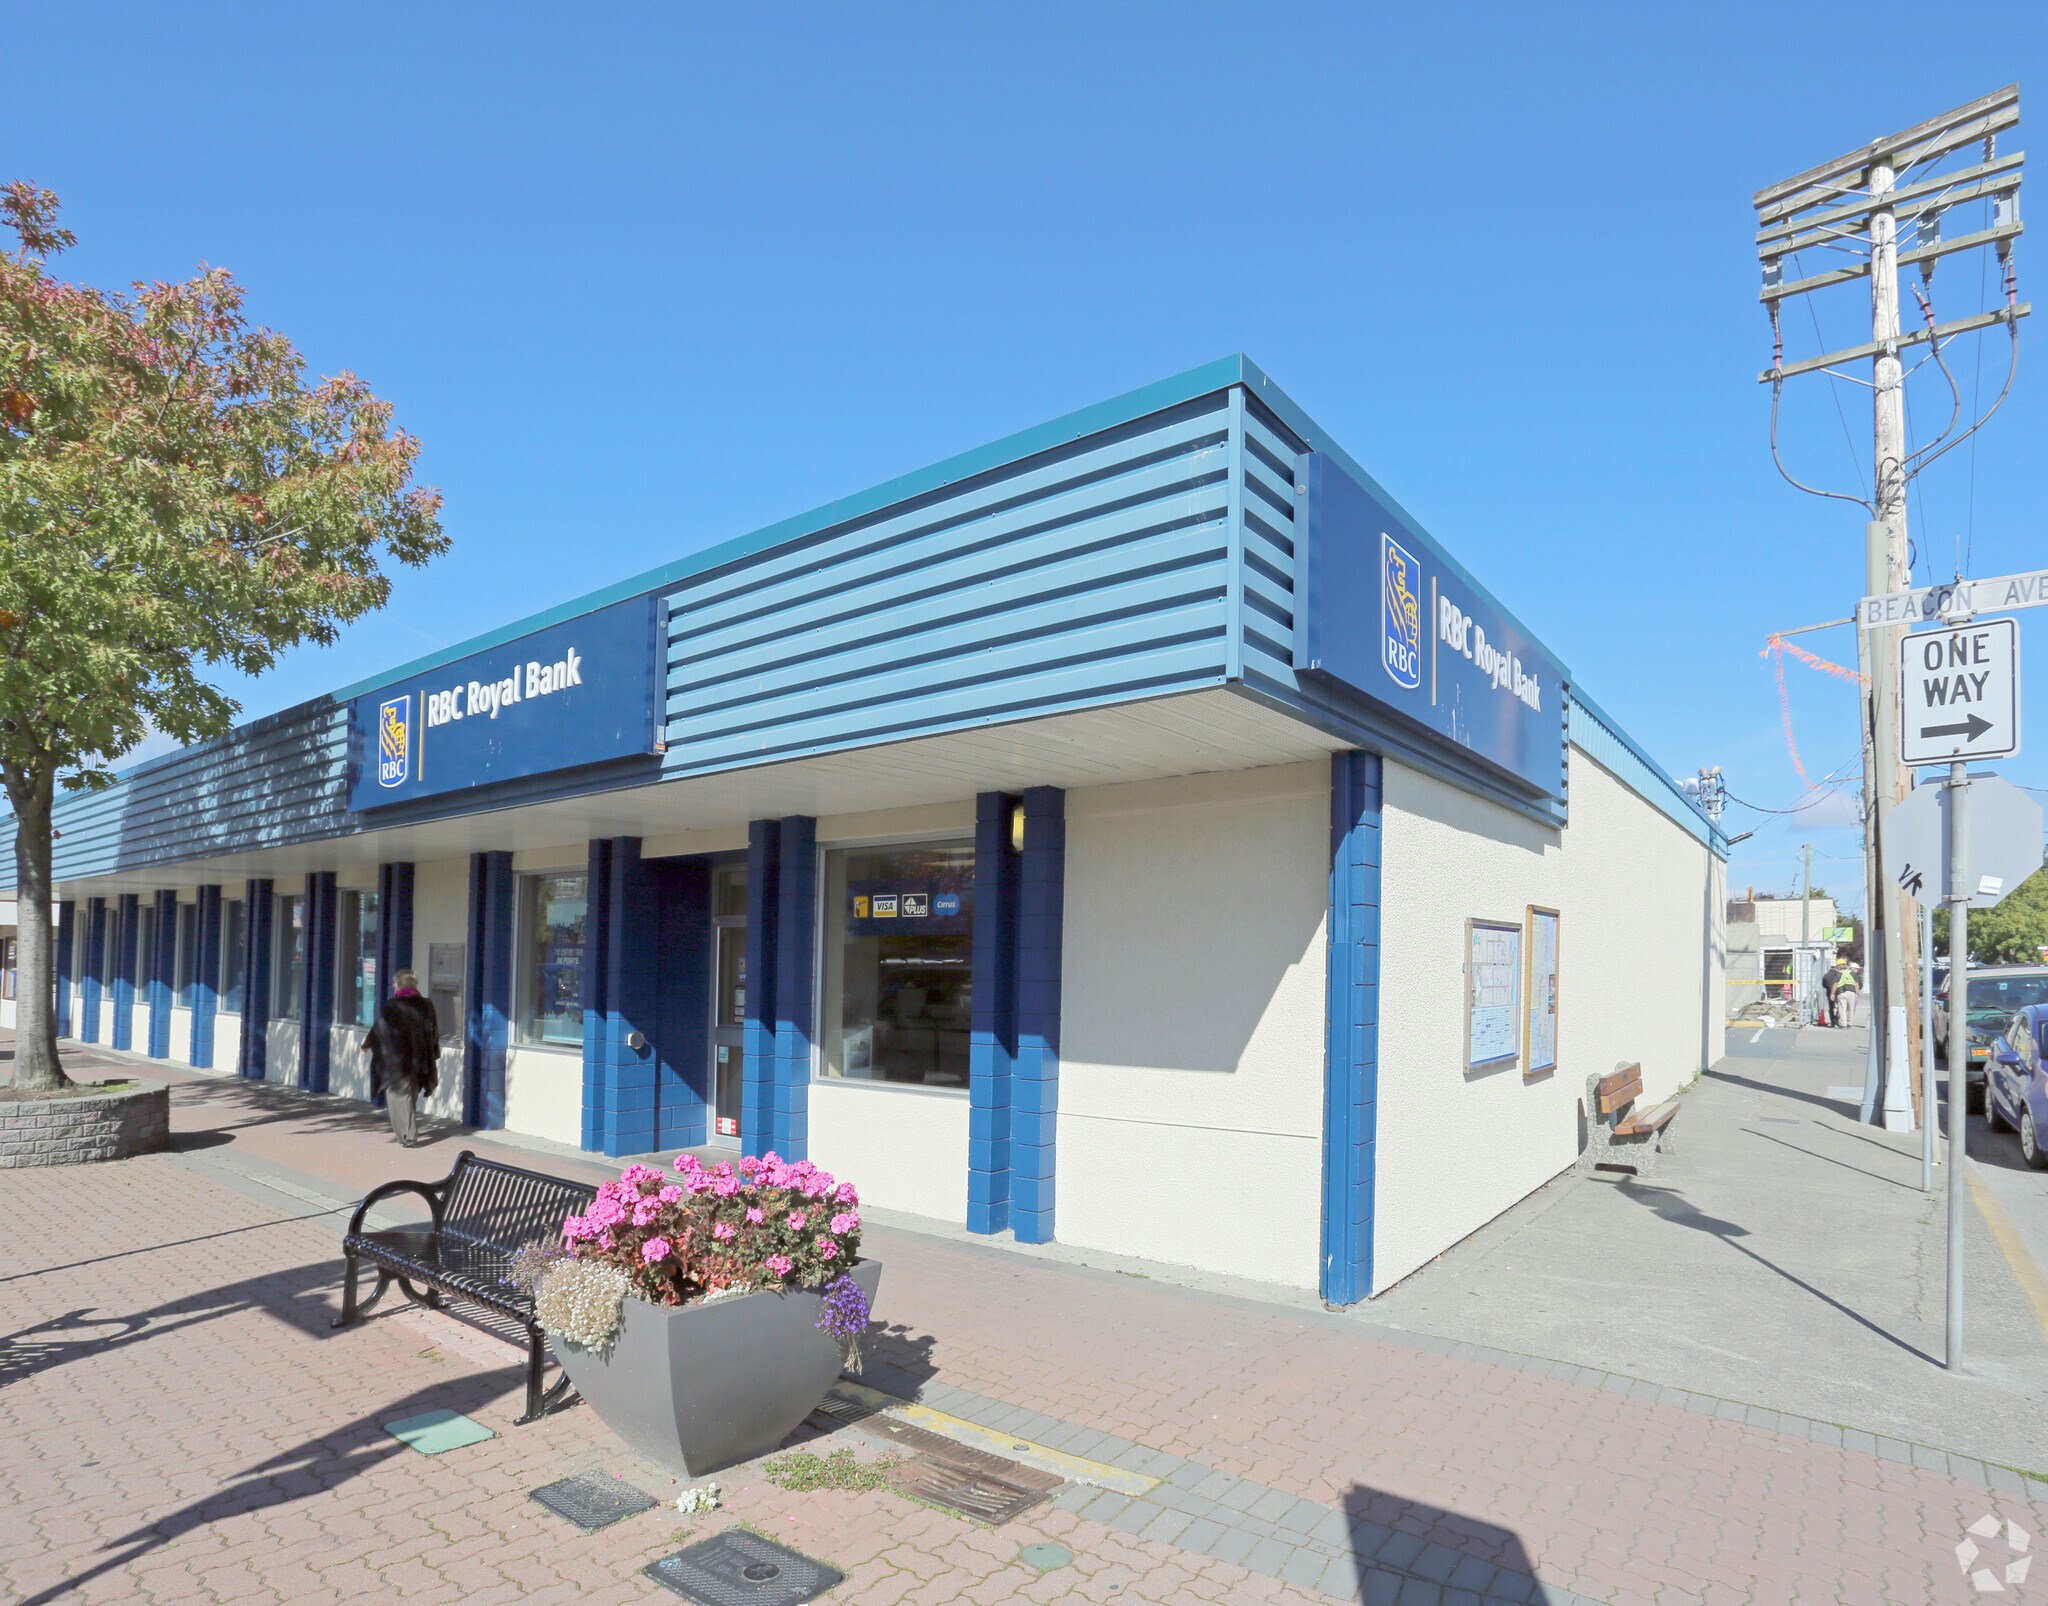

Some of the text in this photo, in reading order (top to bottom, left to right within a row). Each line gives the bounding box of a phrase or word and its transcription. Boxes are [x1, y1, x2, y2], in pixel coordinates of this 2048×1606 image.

[1868, 576, 2048, 624] BEACON AVE
[1388, 636, 1417, 679] RBC
[1440, 595, 1541, 712] RBC Royal Bank
[1924, 633, 1990, 671] ONE
[428, 647, 582, 727] RBC Royal Bank
[1923, 670, 1991, 707] WAY
[382, 758, 404, 781] RBC
[877, 902, 894, 911] VISA
[910, 905, 926, 915] PLUS
